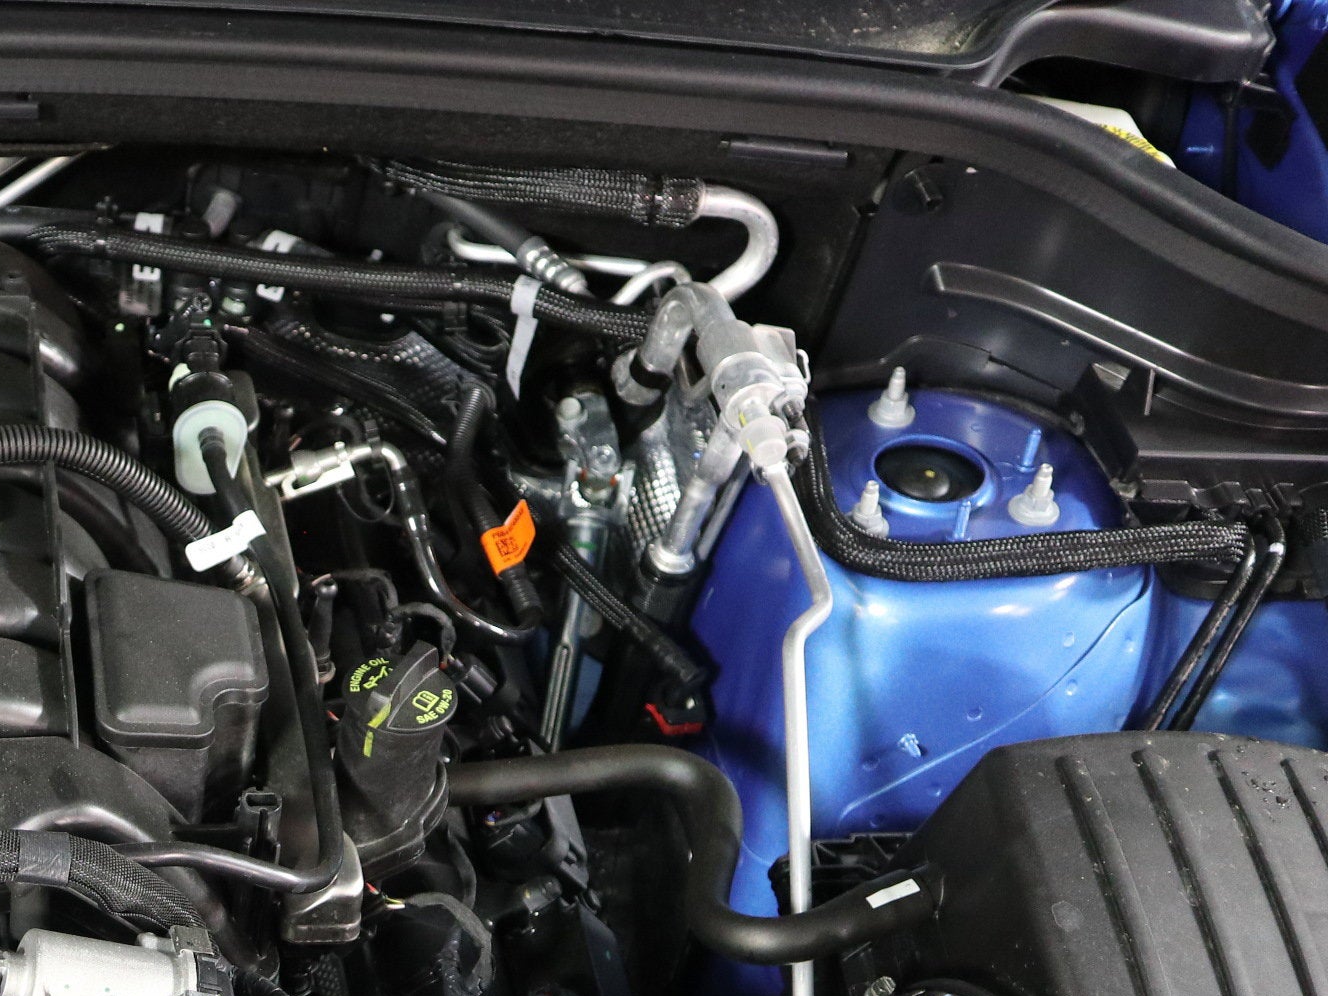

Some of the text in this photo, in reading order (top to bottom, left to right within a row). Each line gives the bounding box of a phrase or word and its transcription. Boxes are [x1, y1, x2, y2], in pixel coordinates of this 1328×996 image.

[349, 657, 390, 692] ENGINE OIL
[415, 689, 453, 725] SAE 0W-20
